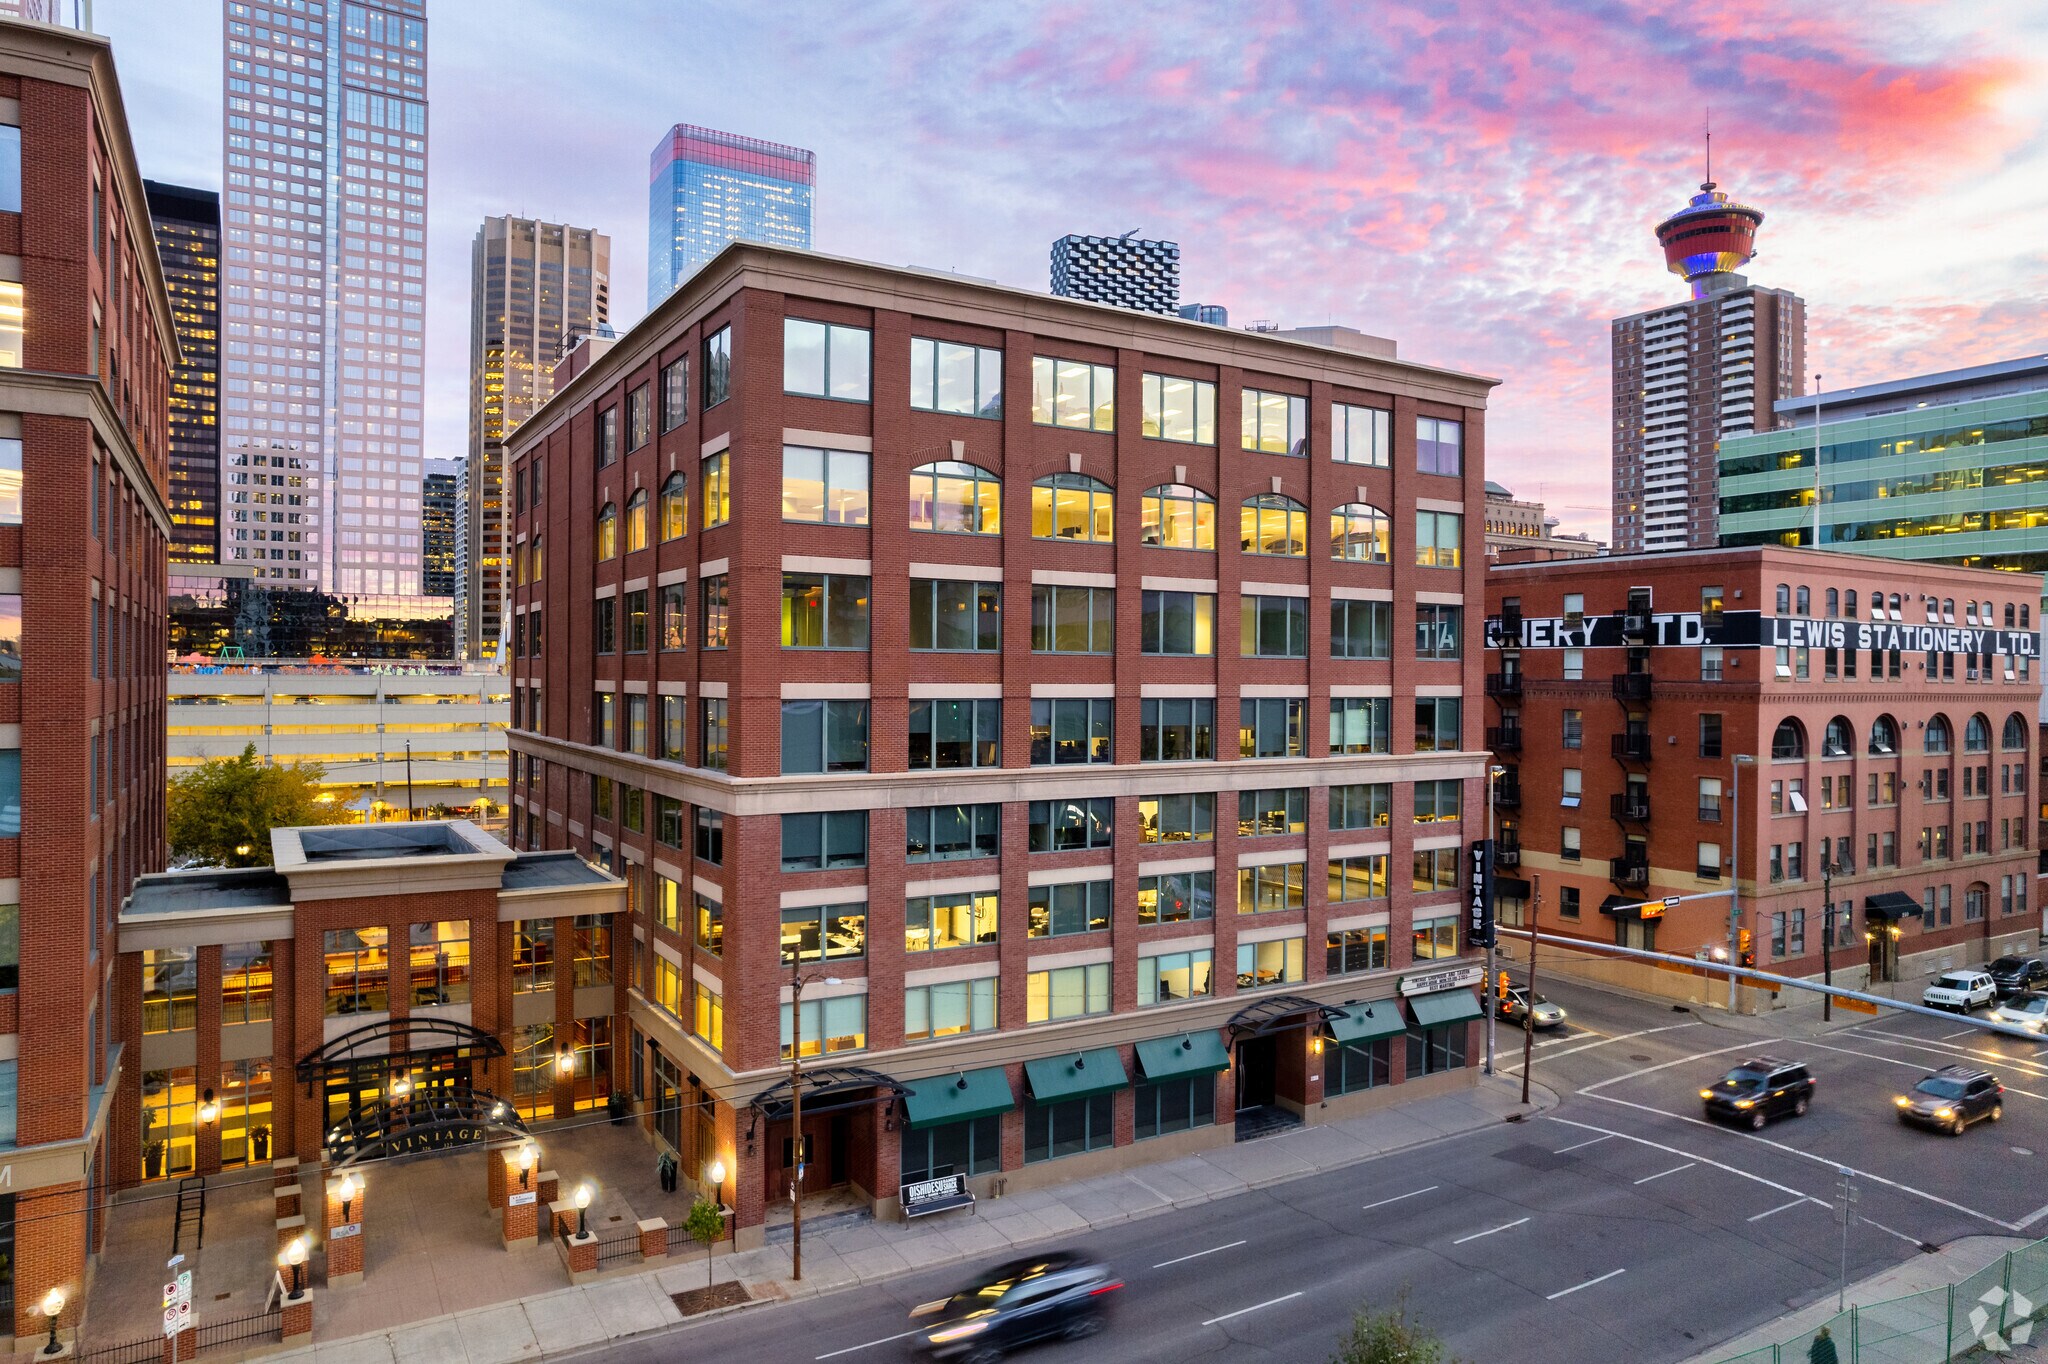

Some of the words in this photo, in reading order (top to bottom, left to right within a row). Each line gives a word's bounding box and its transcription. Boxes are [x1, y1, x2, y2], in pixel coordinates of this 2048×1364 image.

[1773, 619, 1845, 648] LEWIS
[1858, 623, 1986, 653] STATIONERY
[1996, 631, 2035, 655] LTD.
[1473, 850, 1483, 930] VINTAGE
[909, 1179, 944, 1198] OISHIDESU
